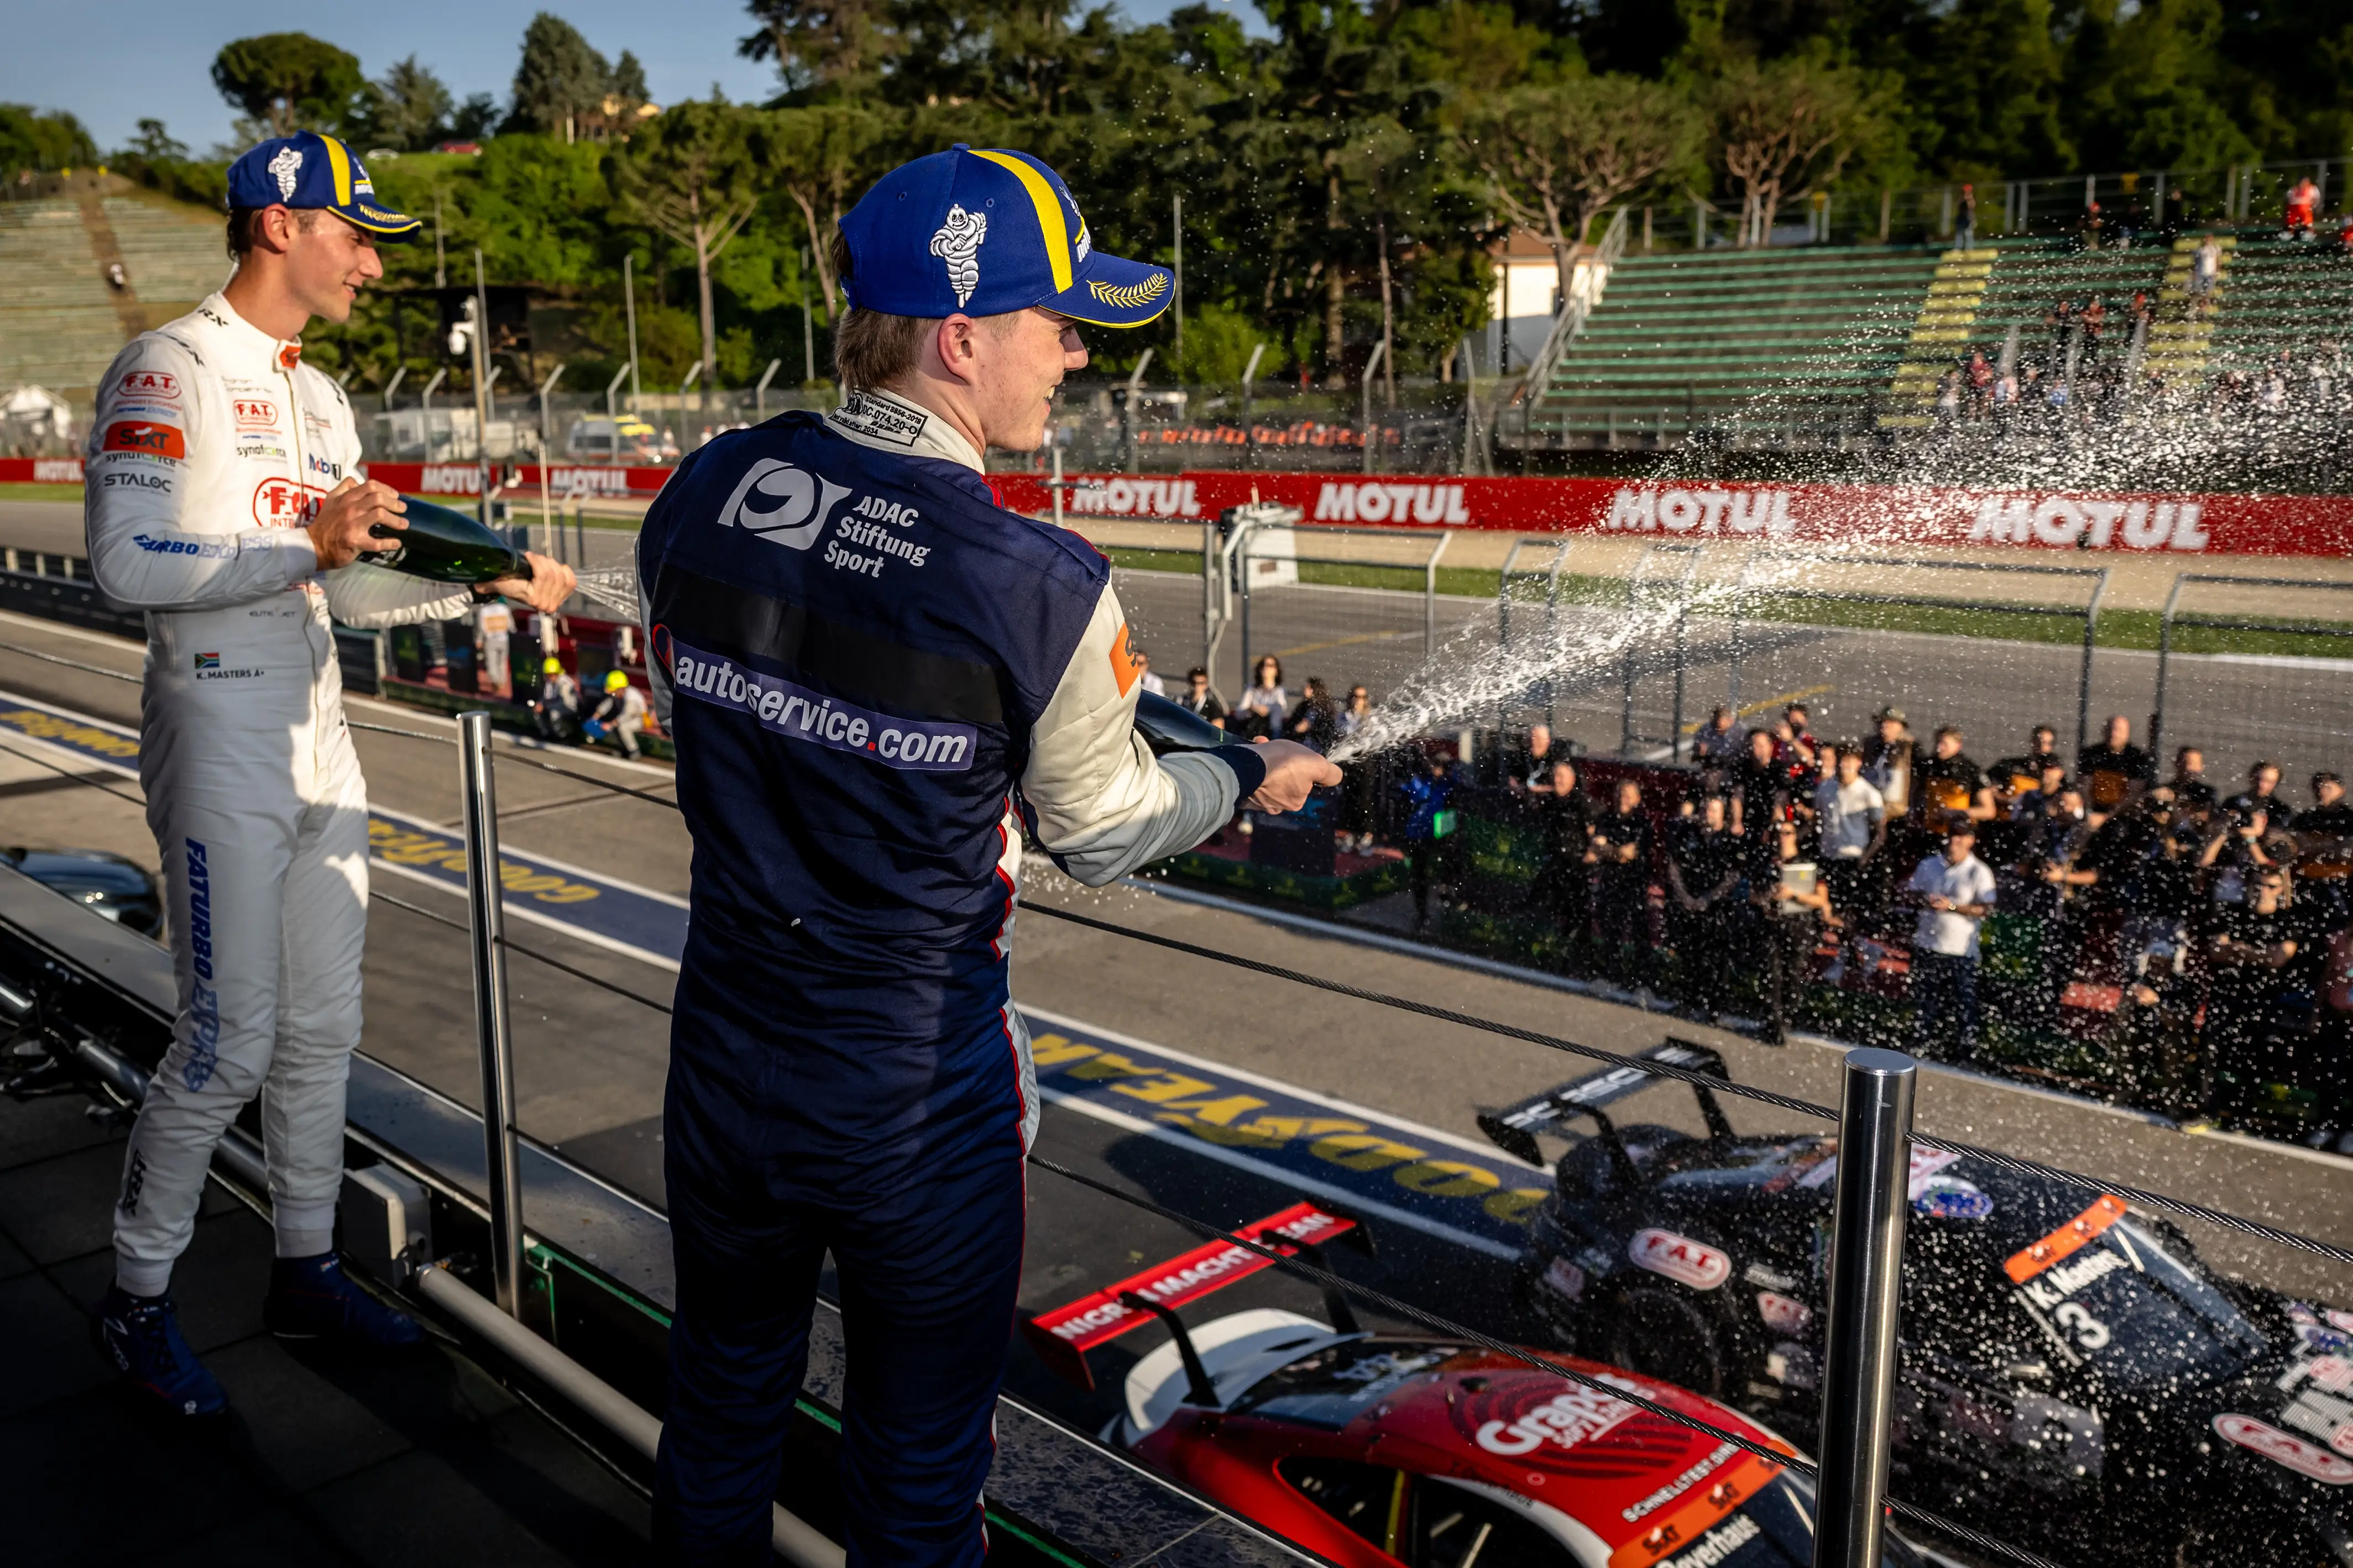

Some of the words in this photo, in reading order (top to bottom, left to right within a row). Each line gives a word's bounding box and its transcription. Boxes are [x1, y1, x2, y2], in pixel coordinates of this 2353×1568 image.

[865, 396, 890, 411] Standard
[891, 407, 922, 425] 8856-2018
[862, 426, 879, 436] 2034
[104, 473, 171, 493] STALOC
[421, 466, 482, 495] MOTU
[1071, 479, 1201, 516] MOTUL
[853, 496, 918, 527] ADAC
[1314, 483, 1470, 524] MOTUL
[1606, 489, 1796, 532] MOTUL
[836, 517, 930, 567] Stiftung
[1968, 497, 2210, 550] MOTUL
[824, 540, 884, 578] Sport
[676, 656, 968, 763] autoservice.com
[185, 837, 214, 981] FATURBO
[2054, 1302, 2110, 1349] 3
